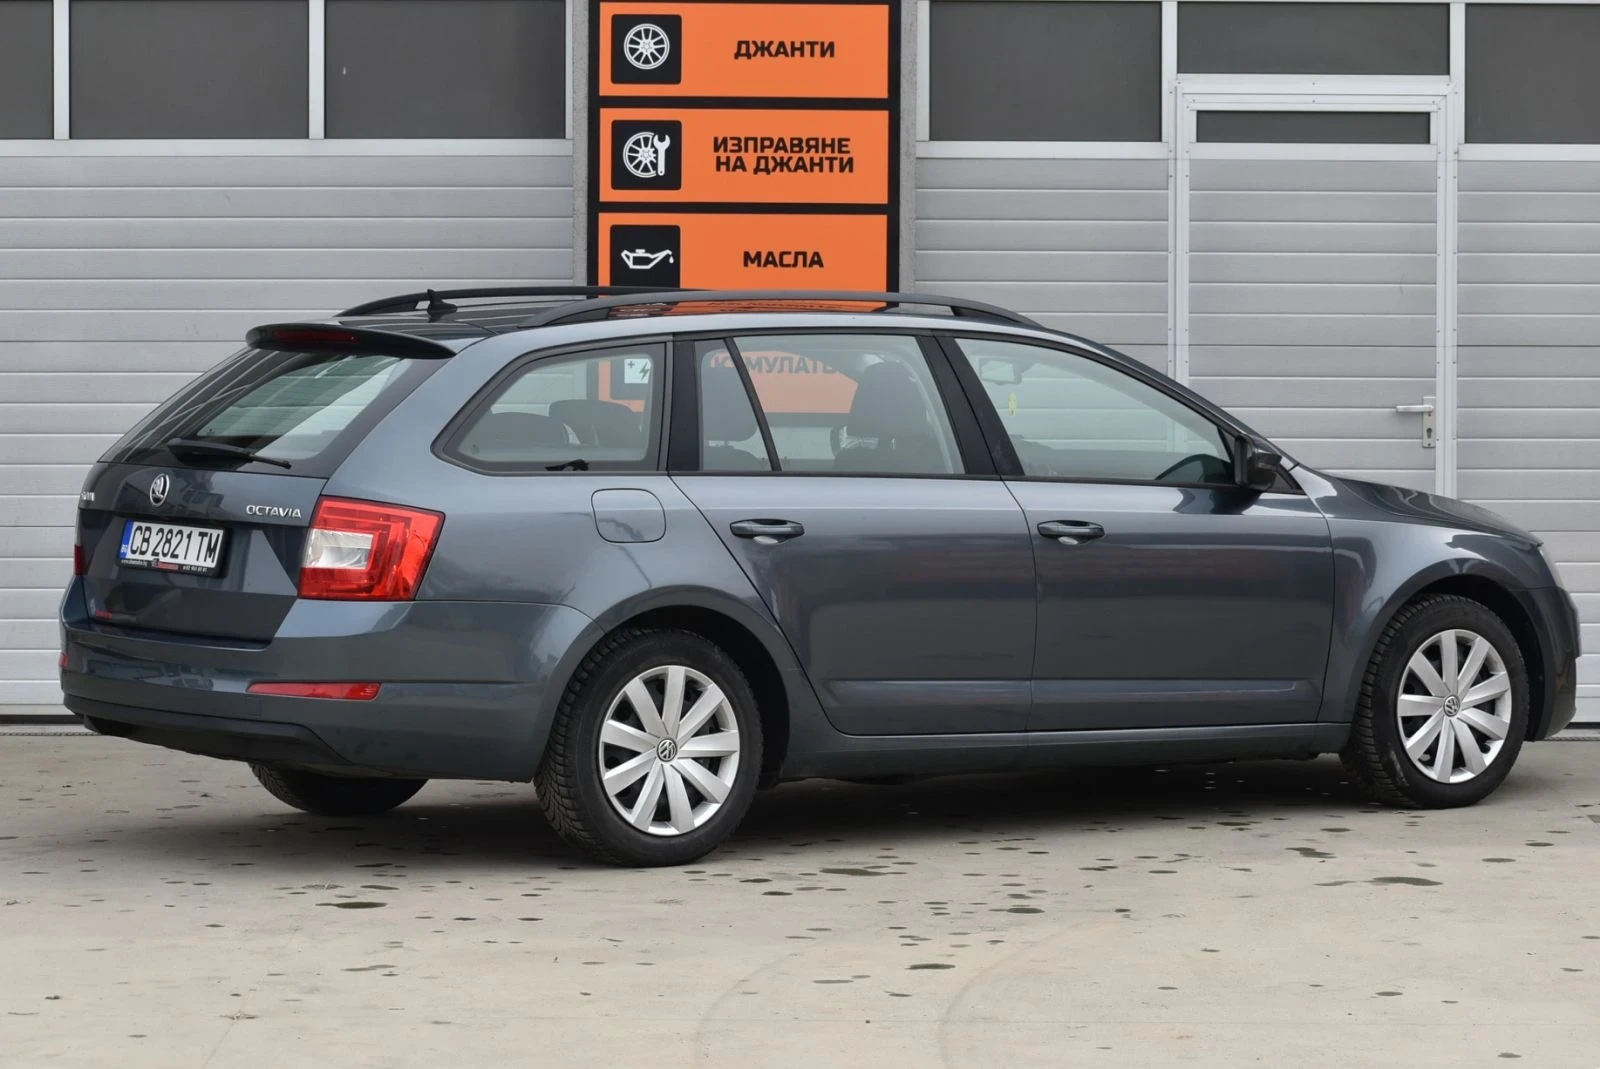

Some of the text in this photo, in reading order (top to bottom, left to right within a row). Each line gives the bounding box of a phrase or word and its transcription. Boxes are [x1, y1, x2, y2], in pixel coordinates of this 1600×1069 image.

[734, 40, 835, 59] ДЖАНТИ
[713, 136, 851, 154] ИЗПРАВЯНЕ
[715, 156, 854, 175] НА ДЖАНТИ
[743, 251, 824, 268] МАСЛА
[246, 504, 302, 519] OCTAVIA
[130, 525, 220, 563] CB 2821 TM
